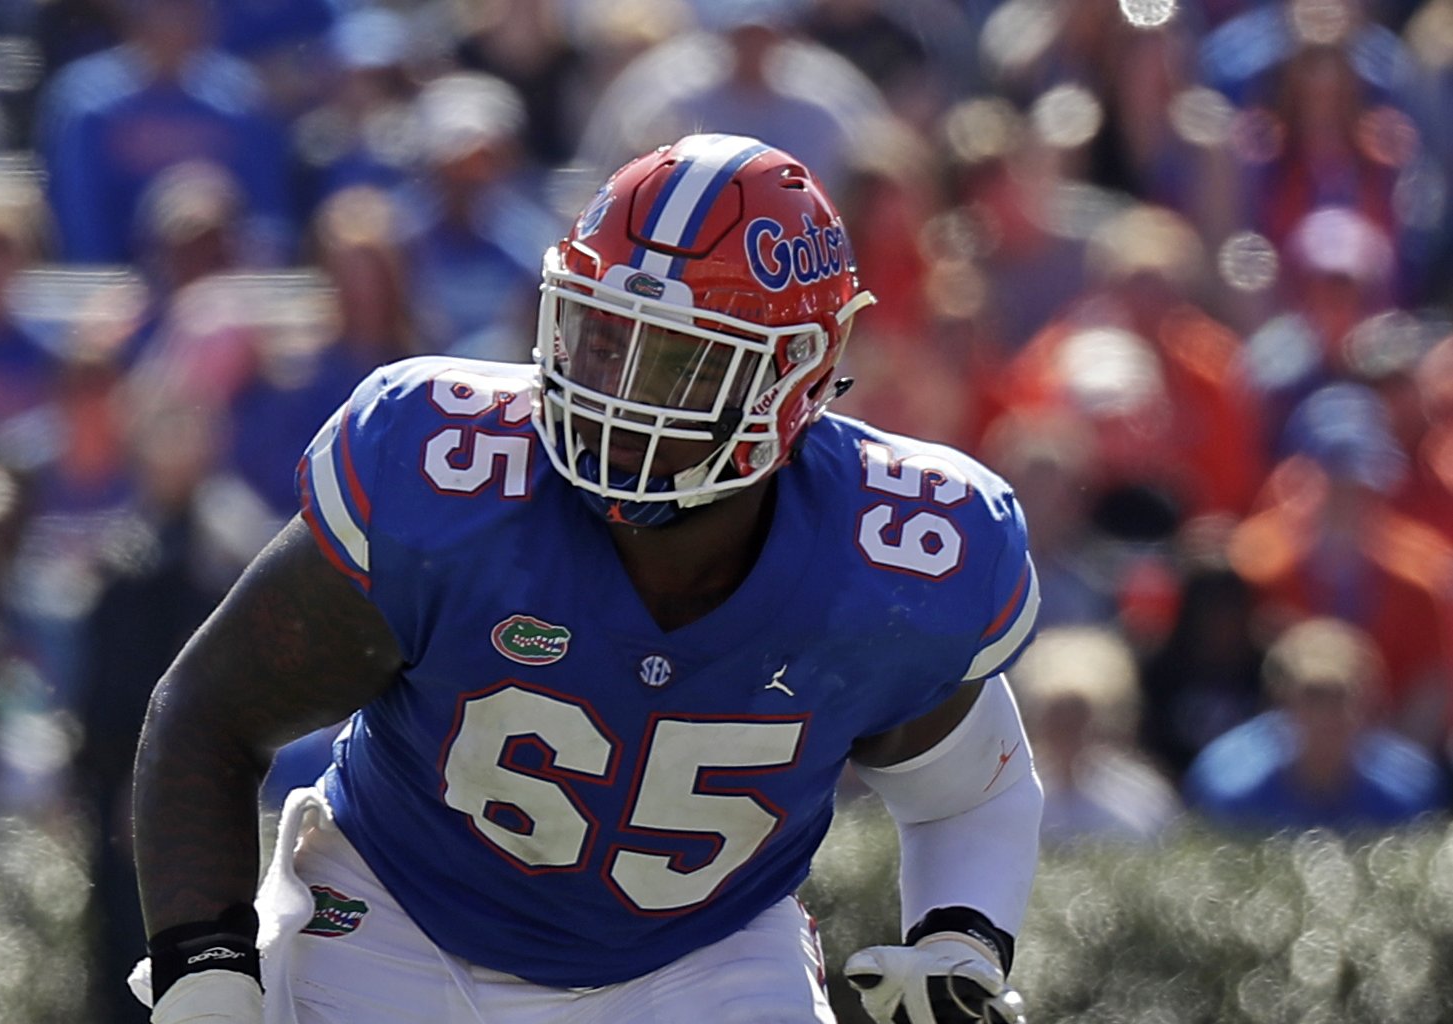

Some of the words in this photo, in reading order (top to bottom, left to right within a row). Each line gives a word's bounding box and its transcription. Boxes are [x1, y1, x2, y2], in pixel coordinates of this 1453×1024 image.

[421, 368, 534, 501] 65
[854, 440, 975, 580] 65
[639, 655, 672, 687] SEC
[439, 679, 811, 916] 65
